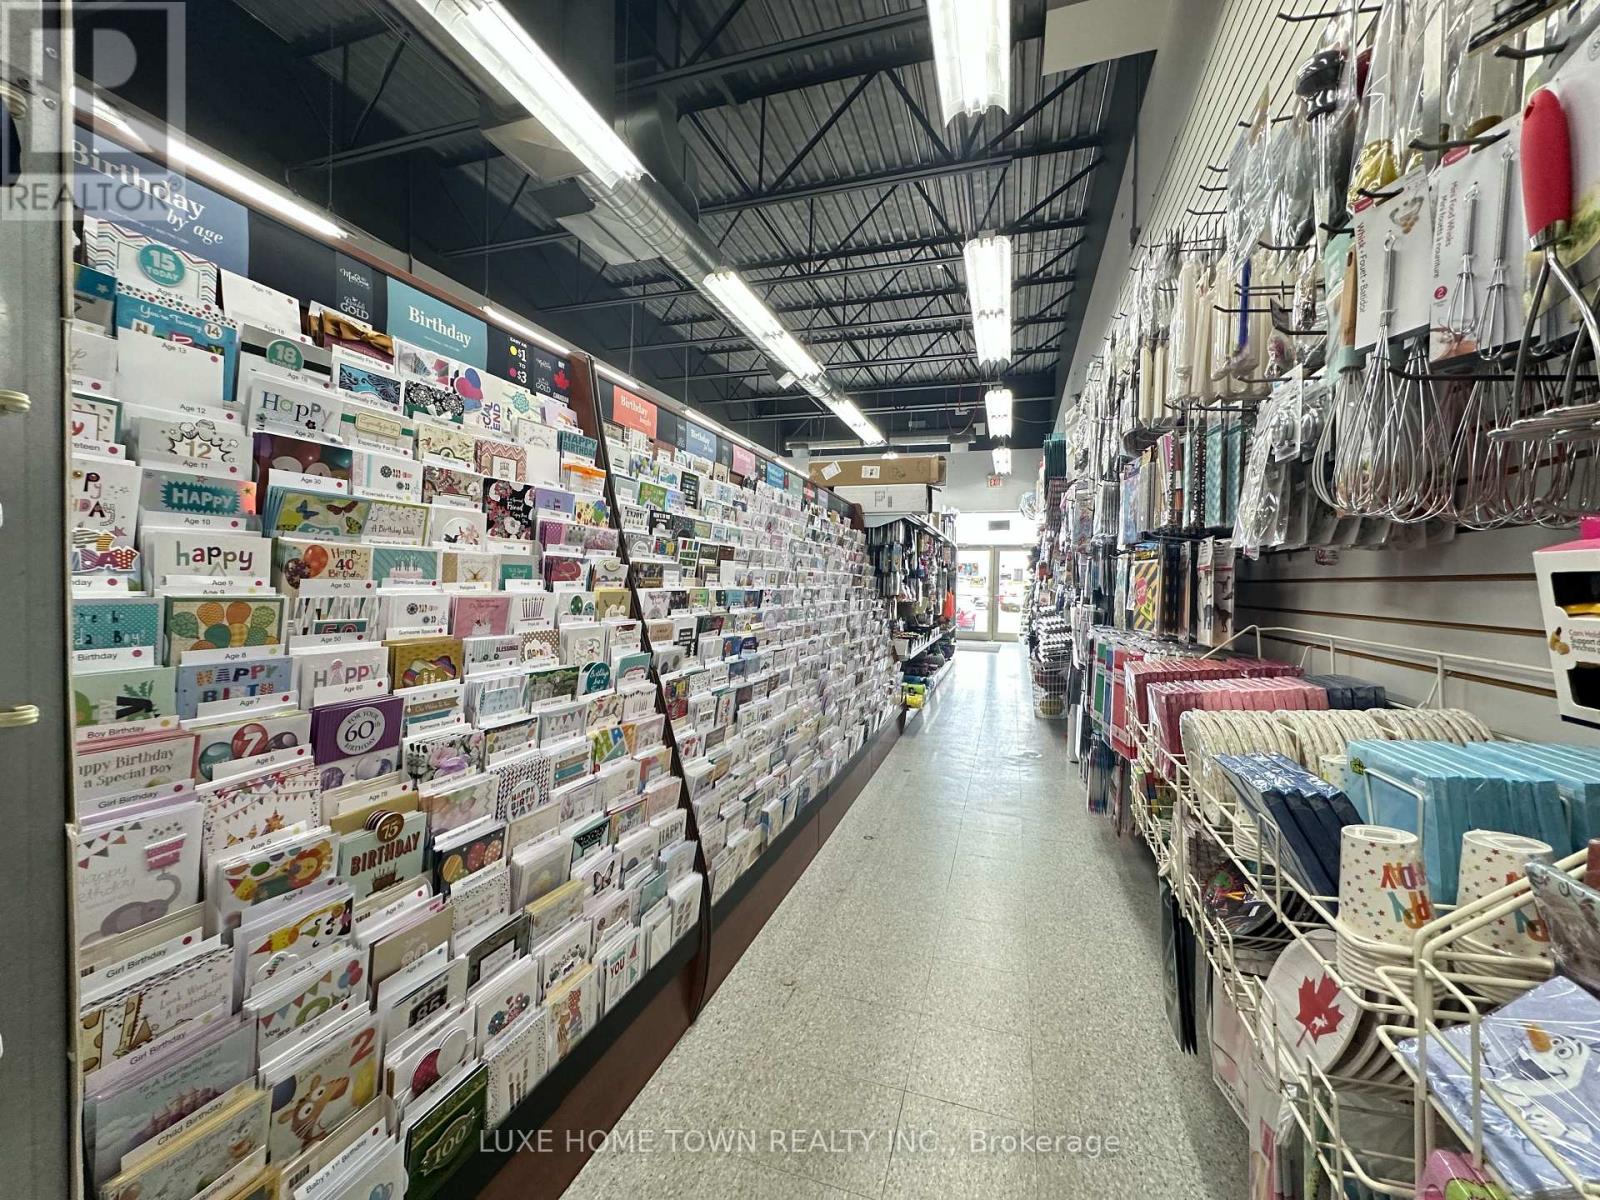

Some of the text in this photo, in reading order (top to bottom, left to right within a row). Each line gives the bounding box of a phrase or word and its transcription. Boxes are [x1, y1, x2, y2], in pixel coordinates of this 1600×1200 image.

[71, 140, 205, 221] Birthday
[166, 208, 189, 233] by
[193, 223, 224, 245] age
[1357, 222, 1366, 249] Whisk
[149, 250, 176, 272] 15
[1359, 254, 1367, 279] Fouet
[146, 266, 179, 281] TODAY
[157, 288, 171, 297] Age
[340, 302, 369, 320] GOLD
[207, 323, 220, 337] 14
[409, 305, 472, 348] Birthday
[162, 342, 176, 351] Age
[275, 344, 297, 362] 18
[518, 349, 527, 362] $1
[287, 373, 301, 381] Age
[517, 370, 527, 384] $3
[180, 403, 195, 412] Age
[295, 430, 306, 438] Age
[185, 441, 212, 460] 12
[182, 460, 197, 468] Age
[301, 477, 312, 485] Age
[184, 517, 199, 525] Age
[176, 541, 253, 571] happy
[331, 548, 362, 560] Happy
[211, 579, 227, 587] Age
[77, 653, 118, 661] Birthday
[196, 664, 279, 687] HAPPY
[344, 686, 355, 694] Age
[239, 699, 255, 708] Age
[347, 713, 361, 724] FOR
[87, 725, 146, 739] Boy Birthday
[244, 731, 263, 758] 7
[115, 748, 176, 768] Birthday
[84, 764, 173, 788] a Special Boy
[98, 791, 159, 809] Girl Birthday
[381, 821, 399, 841] 75
[250, 841, 265, 851] Age
[351, 831, 420, 877] BIRTHDAY
[282, 891, 297, 903] Age
[385, 907, 398, 916] Age
[106, 949, 167, 979] Girl Birthday
[610, 957, 626, 978] YOU
[301, 1024, 314, 1034] Age
[130, 1032, 186, 1065] Girl Birthday
[349, 1028, 376, 1068] 2
[157, 1101, 224, 1146] Child Birthday
[433, 1125, 467, 1164] 100
